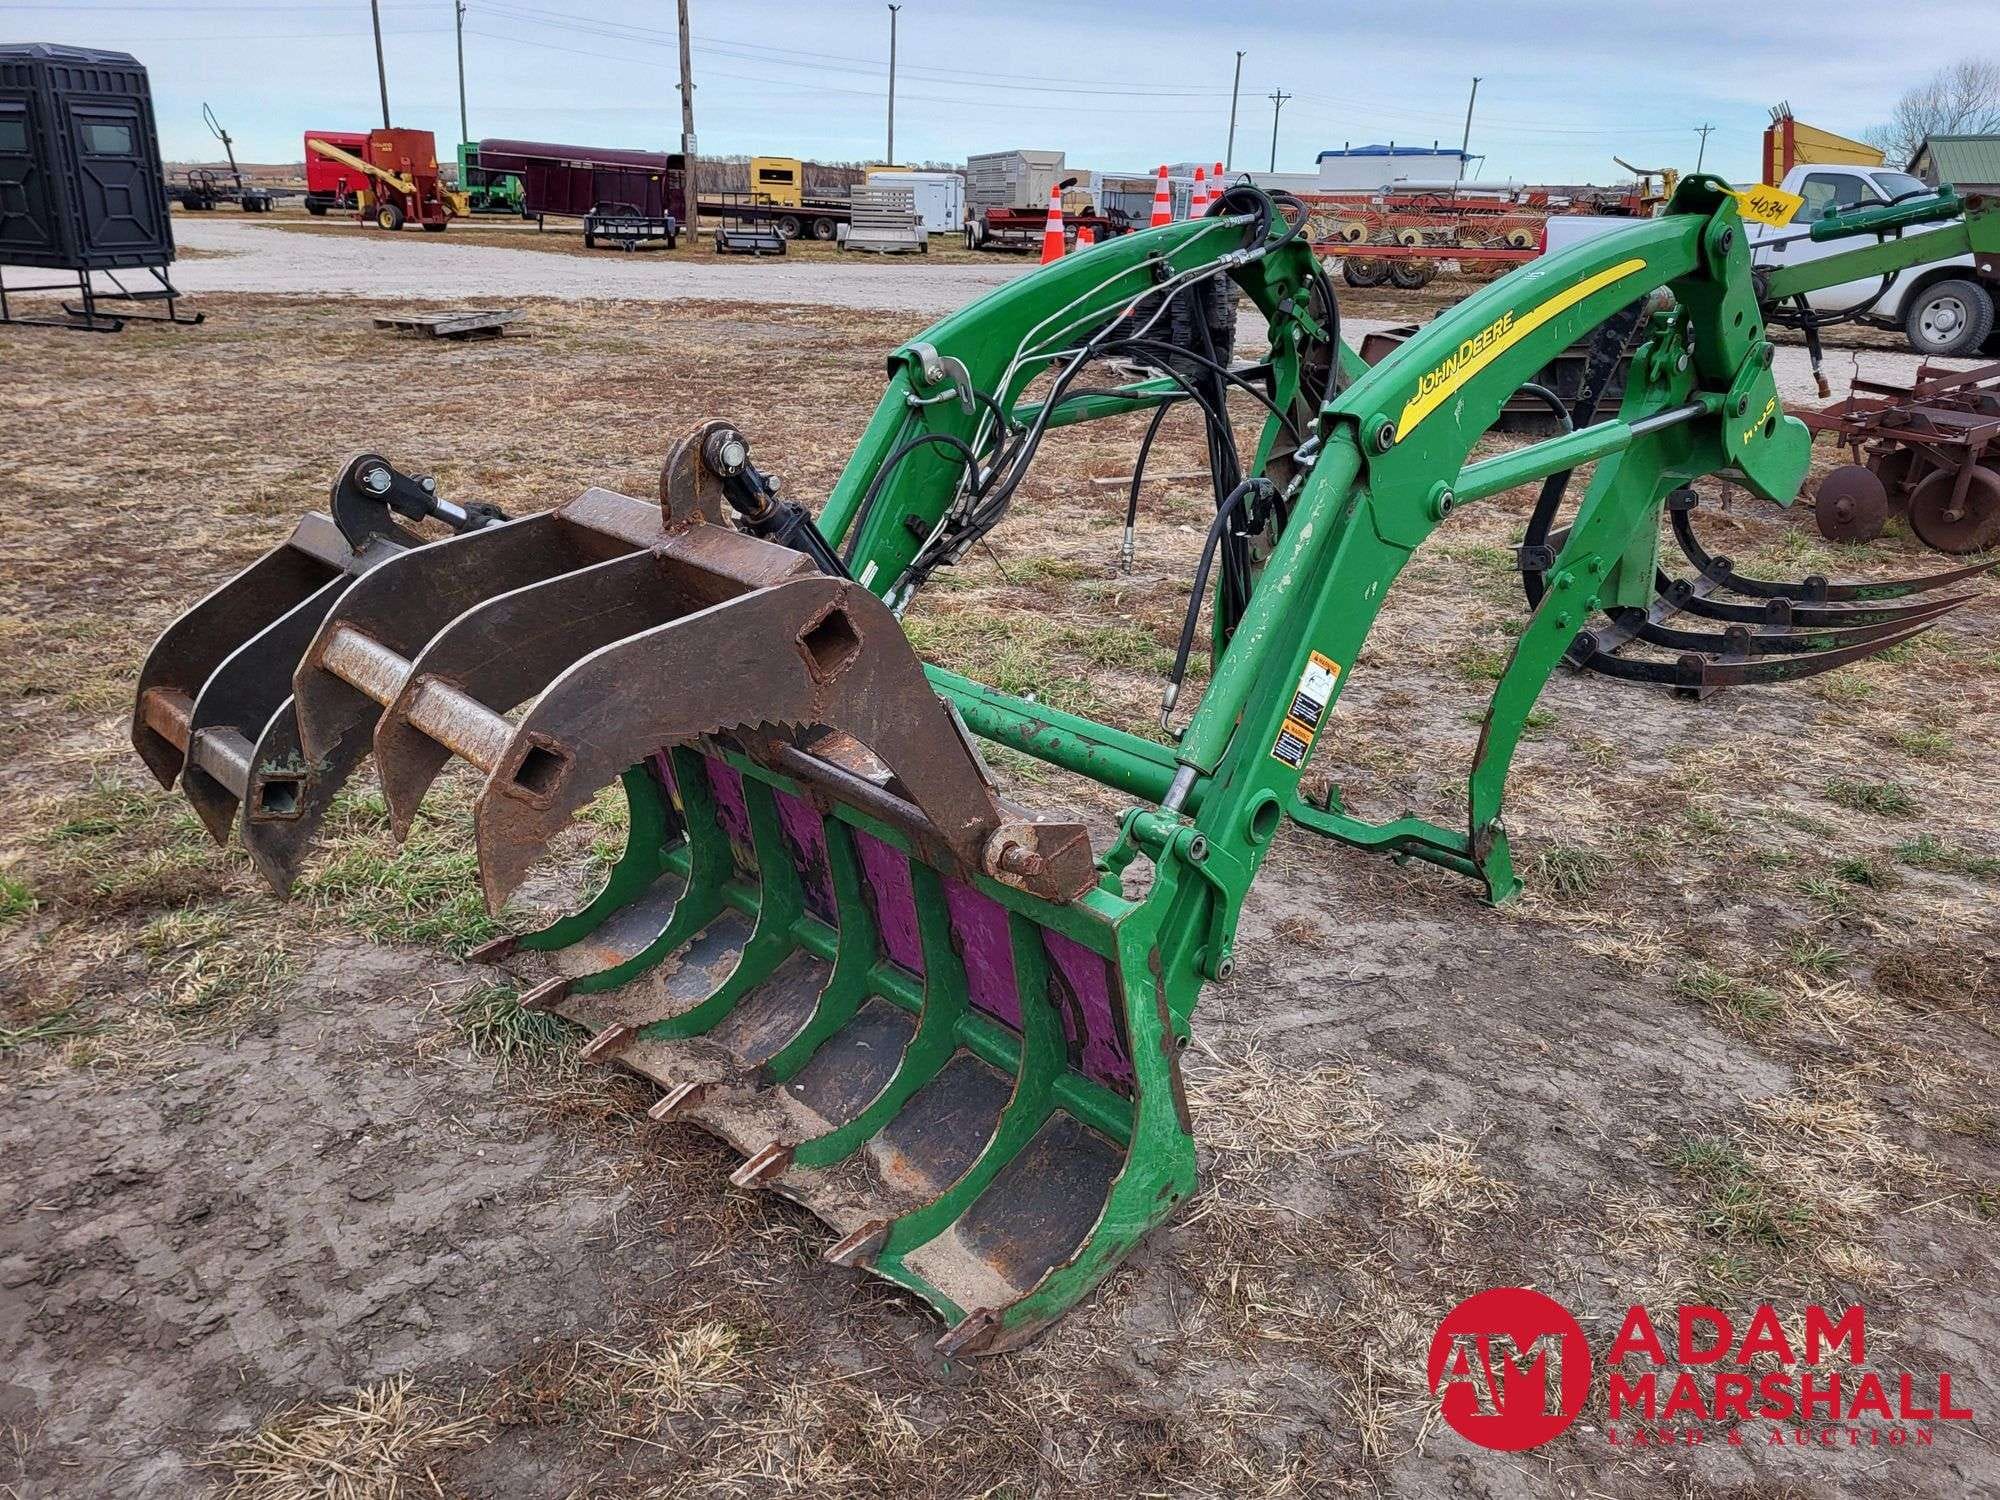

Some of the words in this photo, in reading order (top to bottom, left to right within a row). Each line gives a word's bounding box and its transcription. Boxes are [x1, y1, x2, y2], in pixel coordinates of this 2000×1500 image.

[1750, 196, 1788, 221] 4034
[1411, 358, 1458, 405] JOHN
[1458, 309, 1514, 369] DEERE
